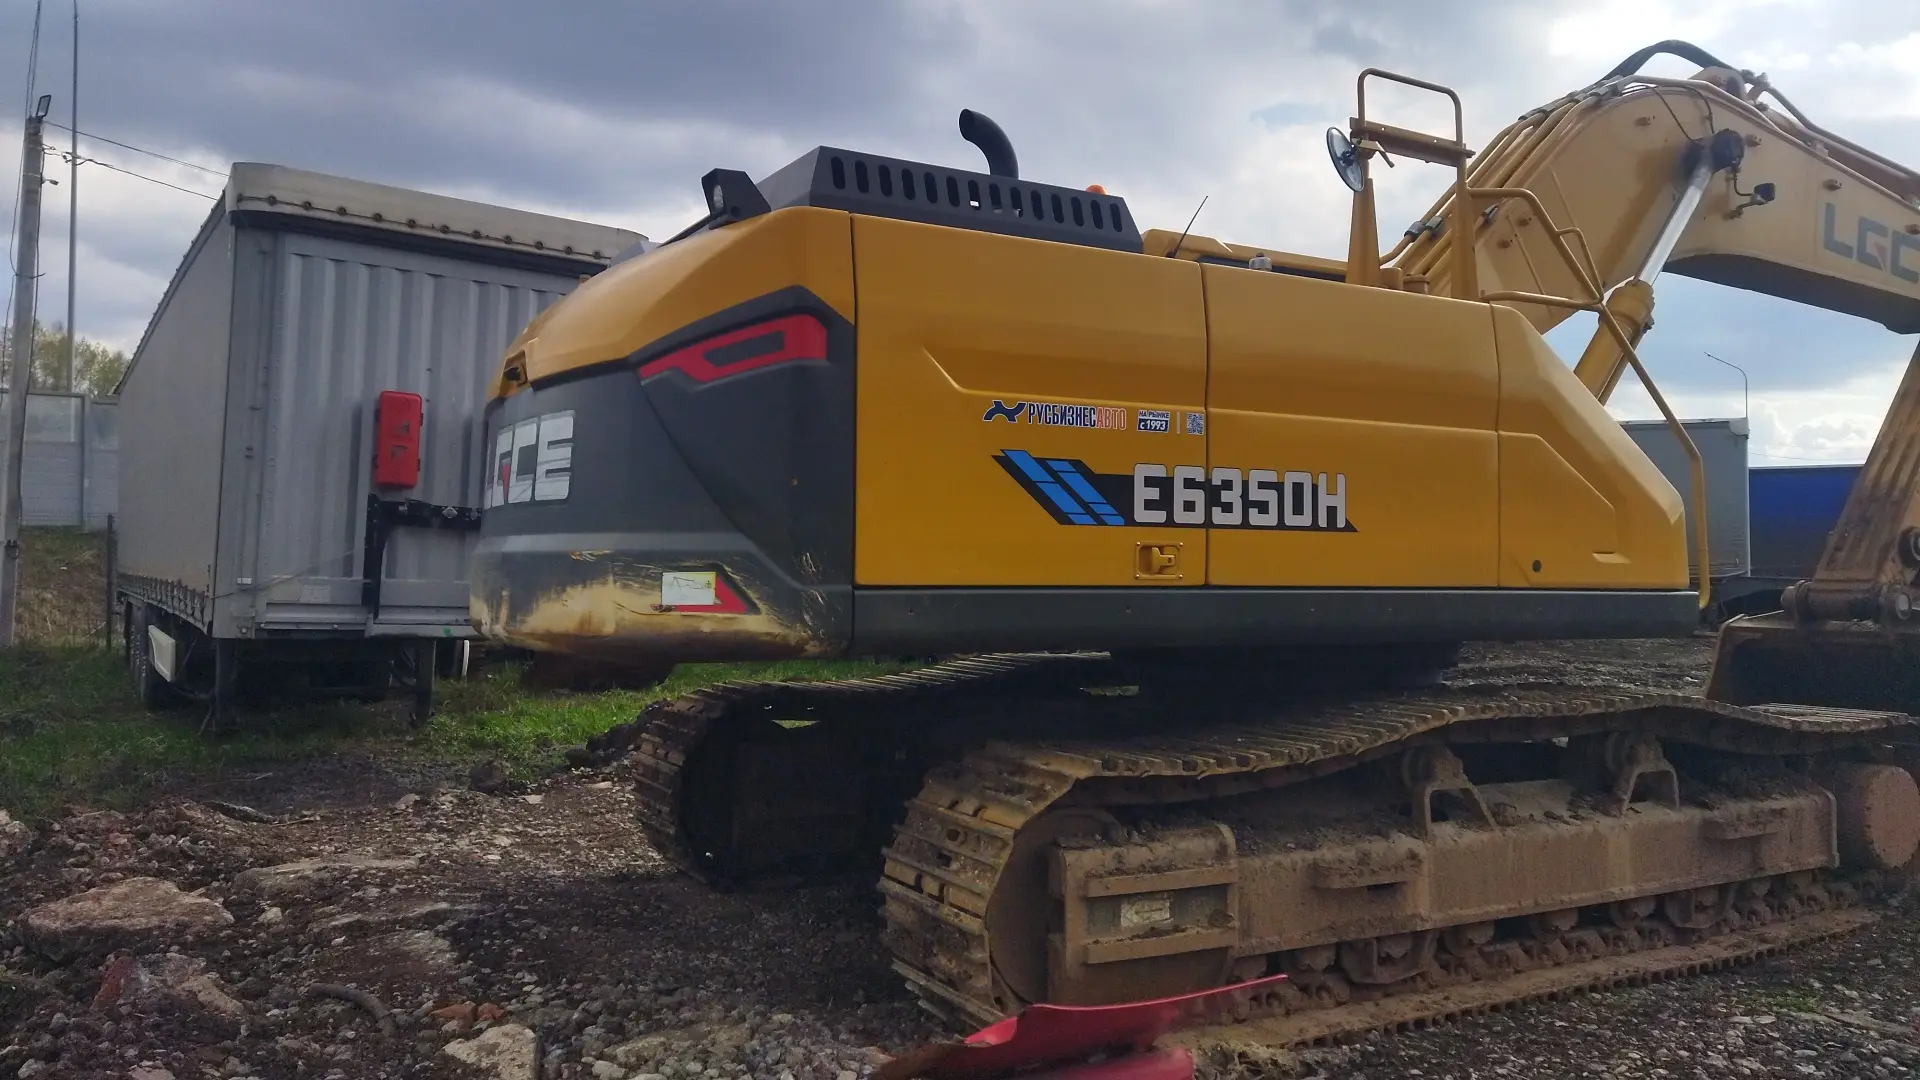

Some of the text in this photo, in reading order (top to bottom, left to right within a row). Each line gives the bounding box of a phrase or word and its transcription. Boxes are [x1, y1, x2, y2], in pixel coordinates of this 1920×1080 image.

[1028, 402, 1126, 430] РУСБИЗНЕСАВТО
[1138, 410, 1170, 419] НА РЫНКЕ
[1146, 420, 1166, 431] 1993
[1134, 463, 1347, 529] E6350H
